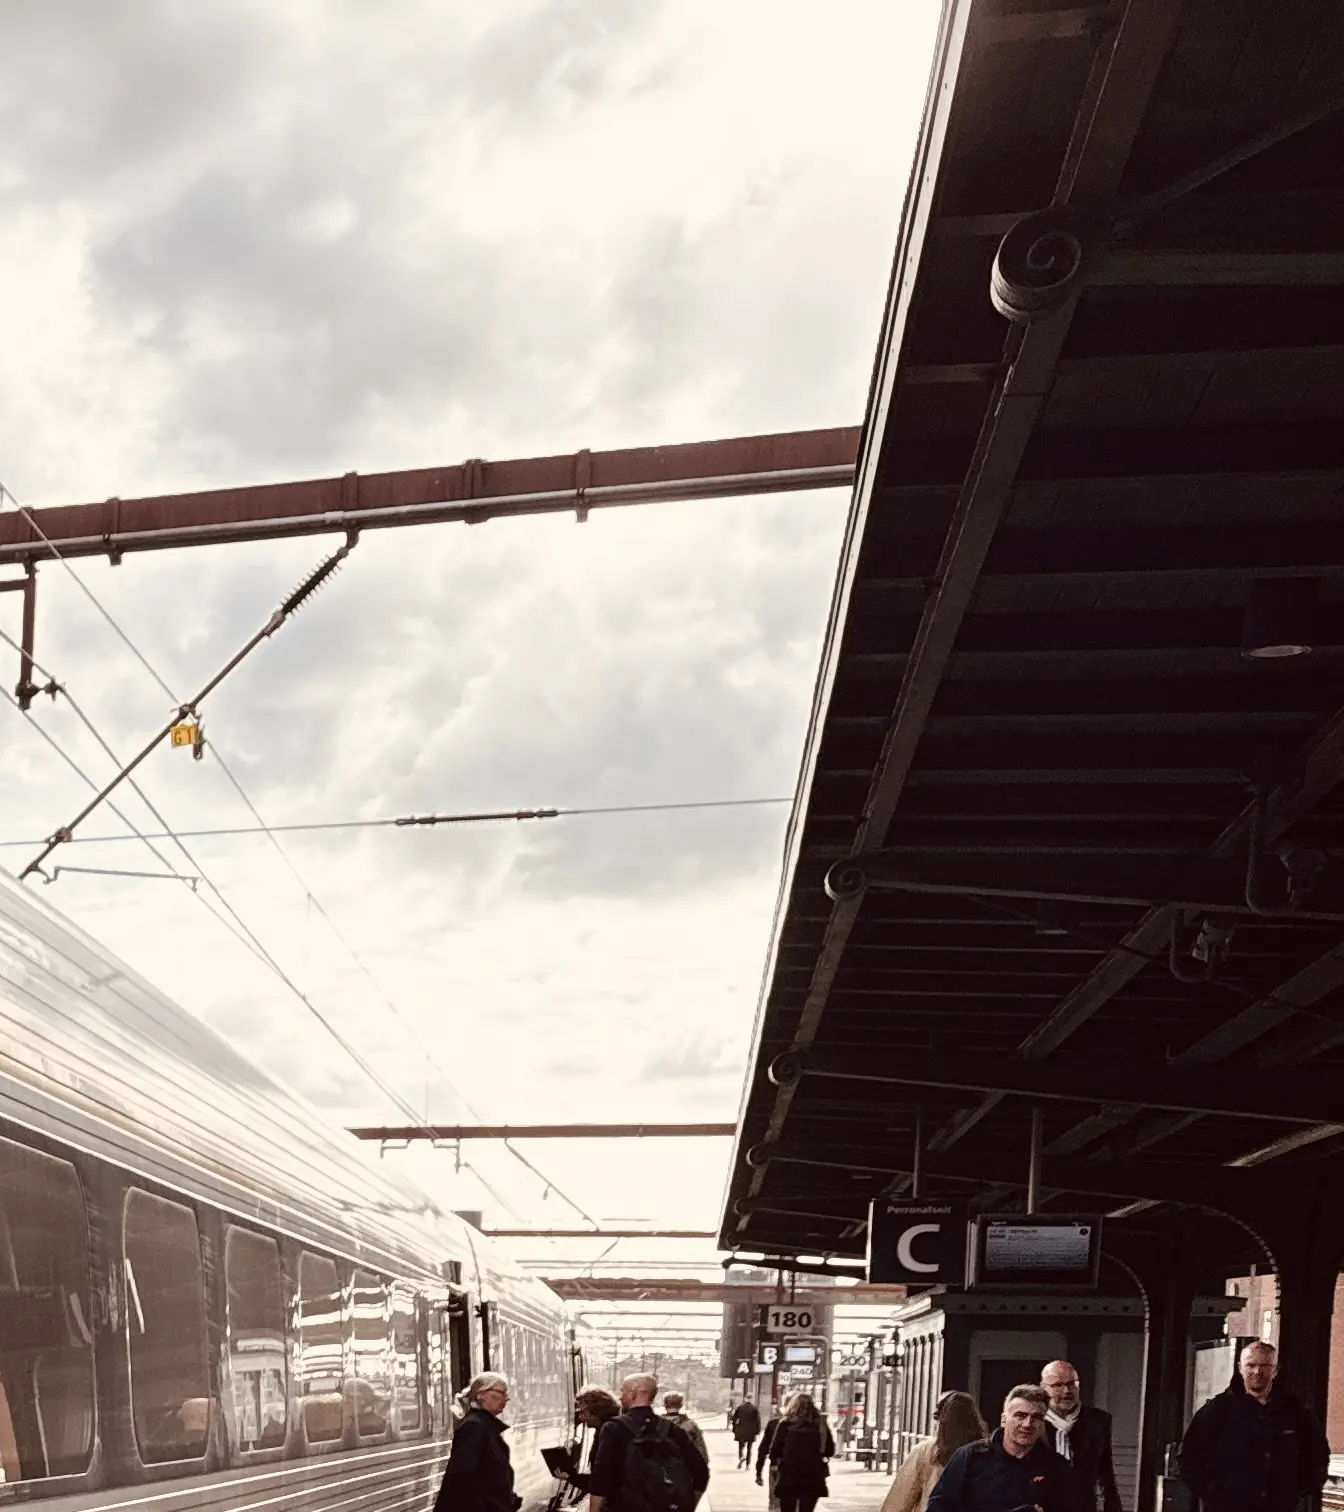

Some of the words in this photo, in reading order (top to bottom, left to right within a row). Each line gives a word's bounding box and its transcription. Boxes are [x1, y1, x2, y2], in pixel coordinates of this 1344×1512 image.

[896, 1223, 940, 1273] C
[771, 1310, 812, 1328] 180
[763, 1347, 778, 1364] B
[737, 1361, 750, 1374] A
